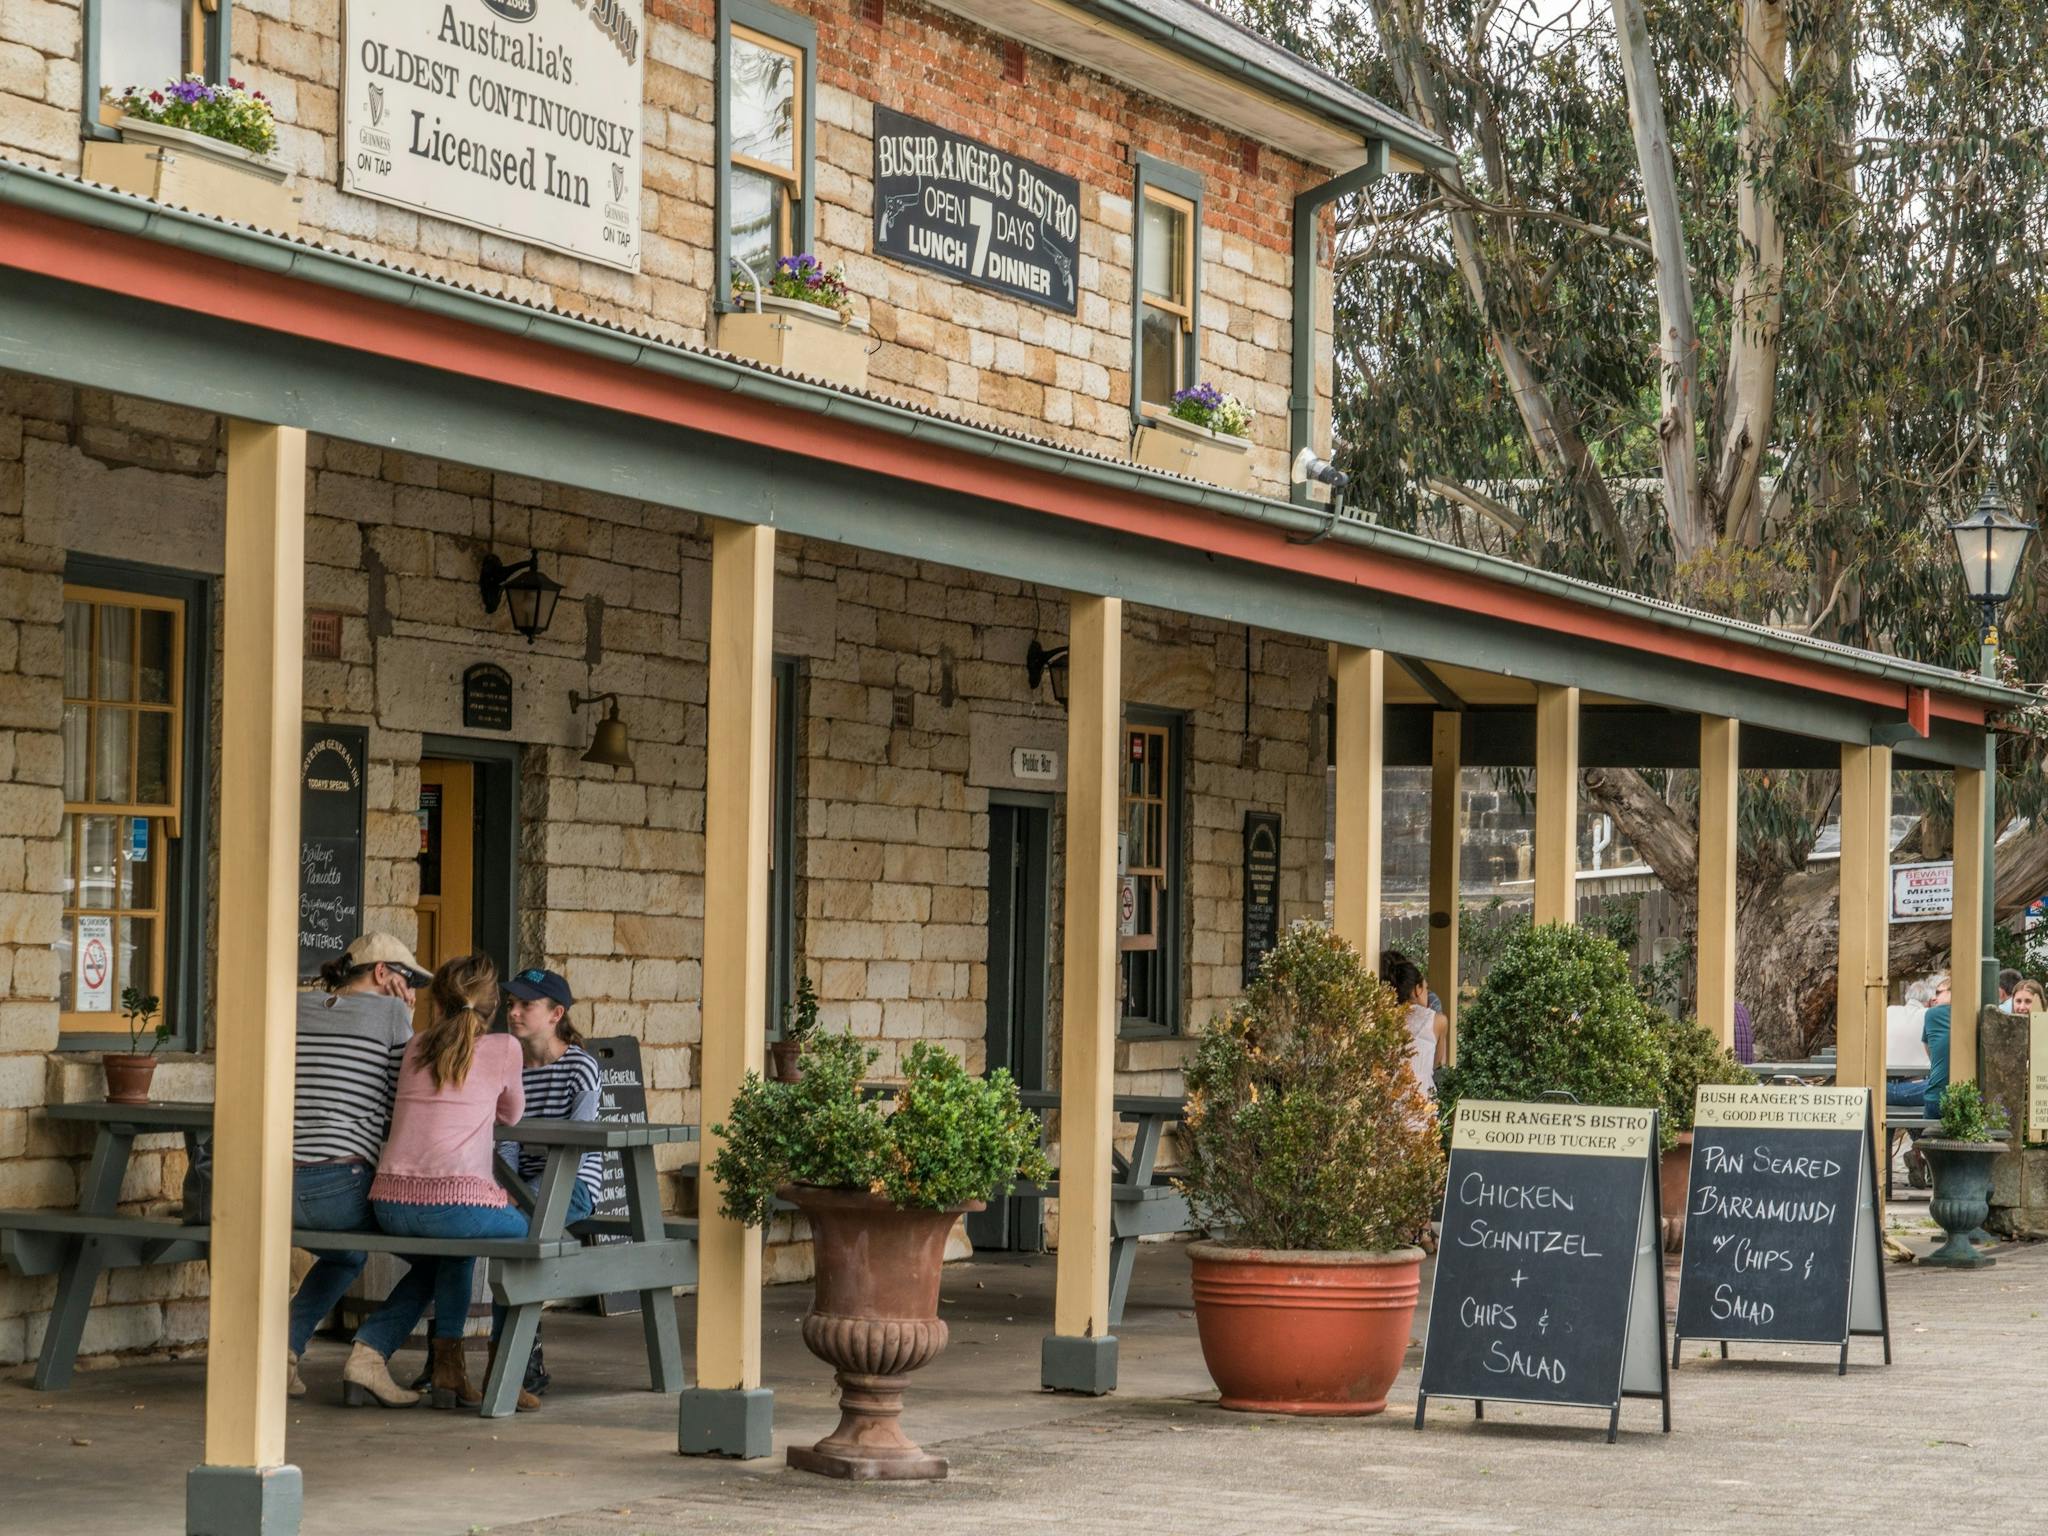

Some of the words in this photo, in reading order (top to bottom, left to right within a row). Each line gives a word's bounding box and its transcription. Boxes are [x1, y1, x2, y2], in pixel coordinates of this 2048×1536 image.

[437, 4, 573, 85] Australia's
[361, 39, 459, 99] OLDEST
[468, 74, 634, 158] CONTINUOUSLY
[358, 153, 371, 172] ON
[374, 157, 391, 176] TAP
[408, 110, 536, 191] Licensed
[544, 152, 590, 208] Inn
[879, 135, 1013, 200] BUSHRANGERS
[1018, 168, 1078, 243] BISTRO
[603, 226, 615, 243] ON
[617, 231, 631, 248] TAP
[924, 187, 965, 228] OPEN
[969, 196, 993, 278] 7
[997, 212, 1035, 251] DAYS
[908, 224, 967, 268] LUNCH
[989, 252, 1051, 296] DINNER
[609, 1068, 638, 1084] GENERAL
[1700, 1092, 1736, 1104] BUSH
[1739, 1092, 1810, 1105] RANGER'S
[1813, 1094, 1863, 1106] BISTRO
[1722, 1110, 1757, 1122] GOOD
[1759, 1111, 1785, 1122] PUB
[1788, 1111, 1837, 1123] TUCKER
[1460, 1108, 1501, 1124] BUSH
[1505, 1110, 1587, 1128] RANGER'S
[1590, 1113, 1649, 1130] BISTRO
[1485, 1131, 1525, 1145] GOOD
[1527, 1132, 1556, 1147] PUB
[1561, 1134, 1617, 1149] TUCKER
[1701, 1145, 1743, 1174] PAN
[1753, 1145, 1841, 1179] SEARED
[1460, 1172, 1575, 1211] CHICKEN
[1693, 1185, 1837, 1224] BARRAMUNDI
[1457, 1219, 1603, 1257] SCHNITZEL
[1510, 1269, 1529, 1288] +
[1735, 1238, 1793, 1273] CHIPS
[1804, 1252, 1814, 1280] &
[1460, 1296, 1517, 1330] CHIPS
[1537, 1308, 1550, 1335] &
[1710, 1283, 1774, 1326] SALAD
[1482, 1340, 1567, 1384] SALAD
